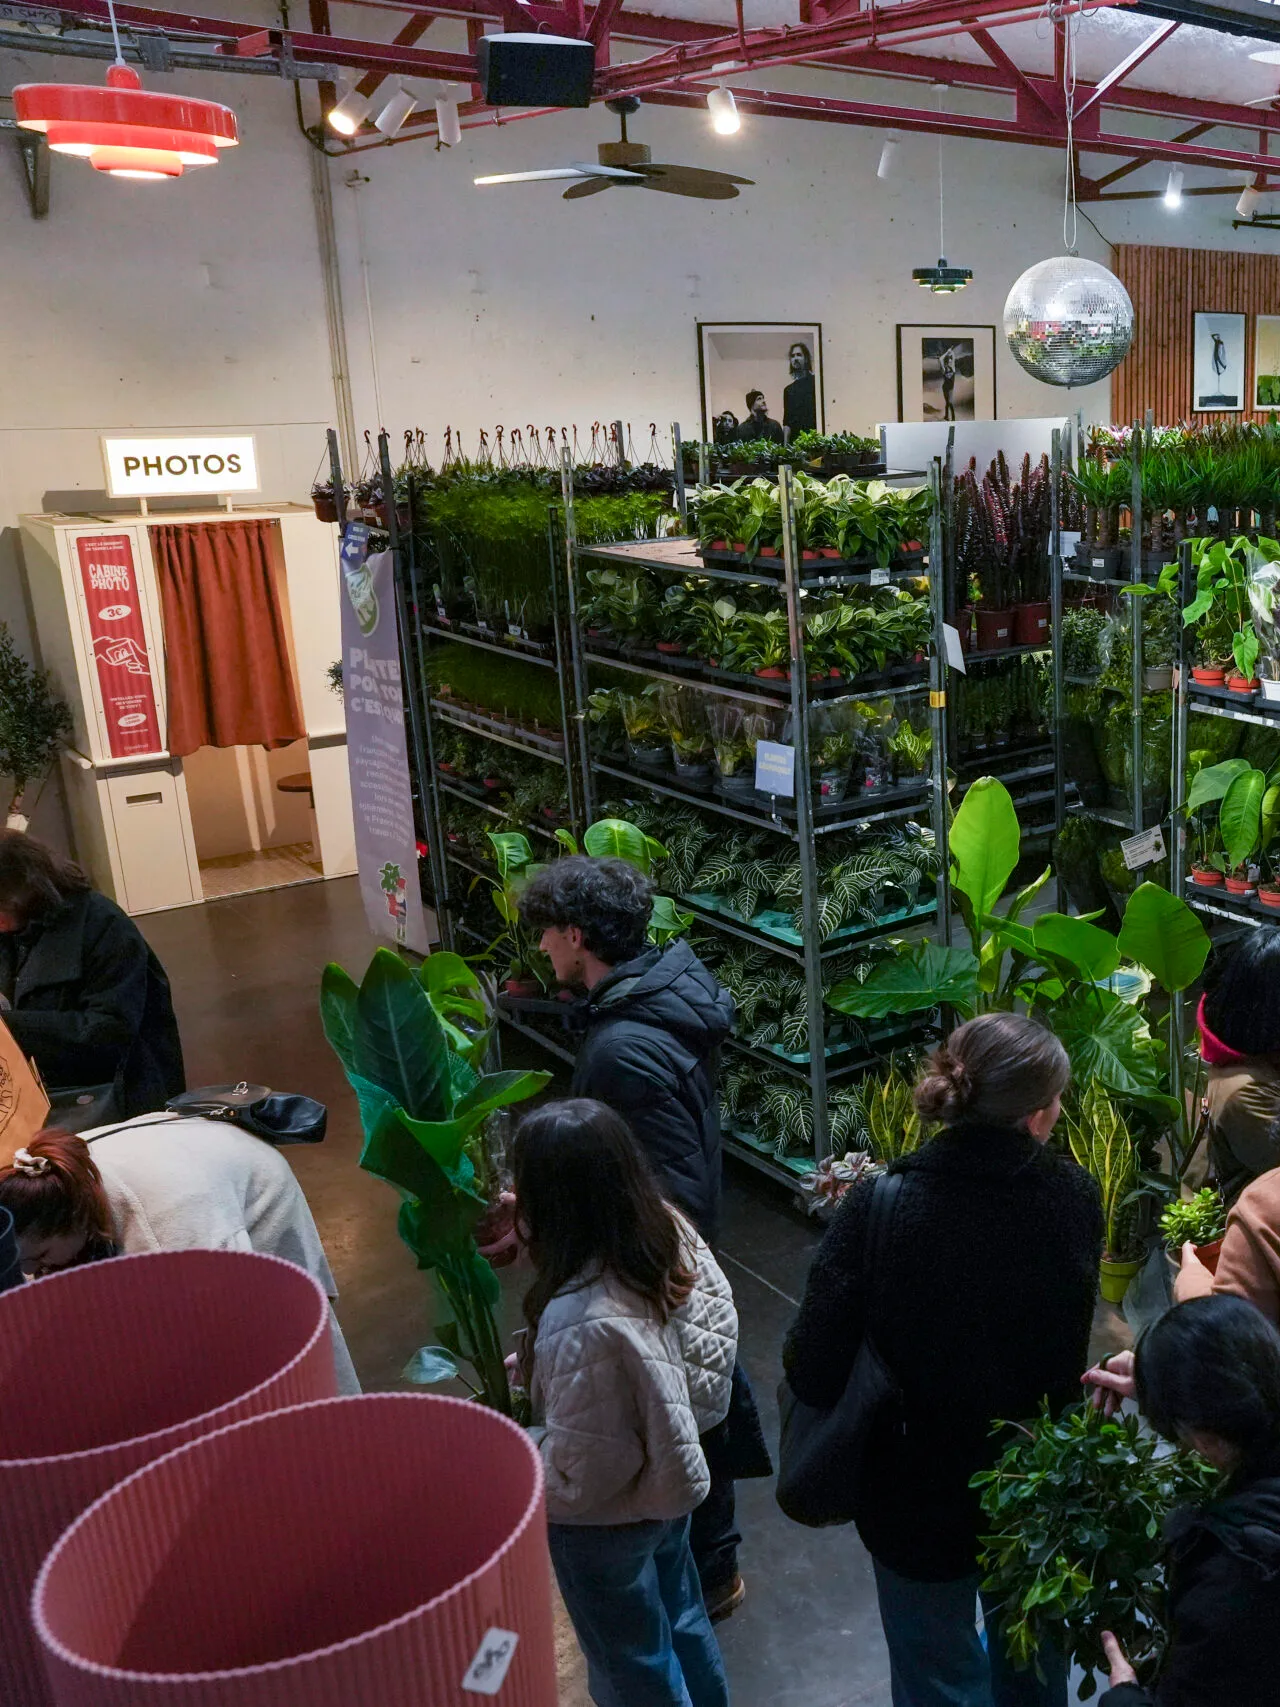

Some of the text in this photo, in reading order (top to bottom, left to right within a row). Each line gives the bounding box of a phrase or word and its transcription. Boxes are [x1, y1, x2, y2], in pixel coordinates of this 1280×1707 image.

[123, 453, 242, 477] PHOTOS
[88, 563, 128, 579] CABINE
[90, 575, 130, 591] PHOTO
[107, 607, 123, 618] 3€
